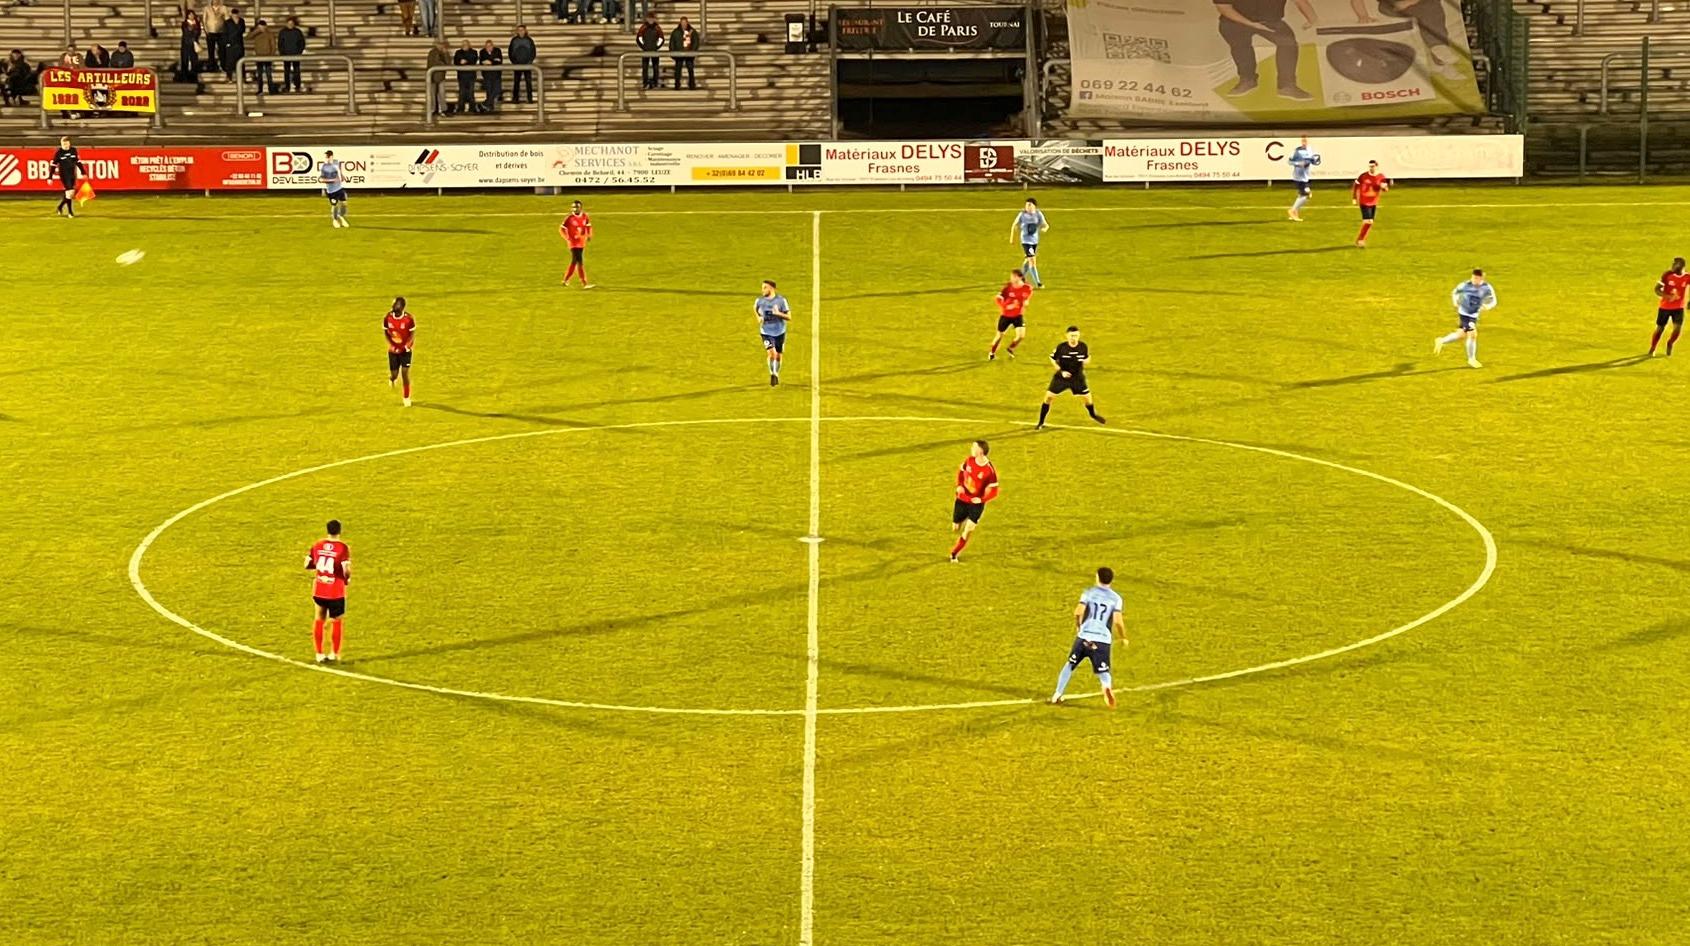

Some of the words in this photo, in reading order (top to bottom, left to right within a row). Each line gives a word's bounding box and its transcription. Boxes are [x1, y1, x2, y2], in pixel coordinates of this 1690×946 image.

[50, 70, 72, 82] LES
[78, 72, 150, 84] ARTILLEURS
[1080, 80, 1114, 90] 069
[1118, 80, 1138, 91] 22
[1144, 82, 1166, 94] 44
[1172, 87, 1192, 98] 62
[1361, 88, 1420, 100] BOSCH
[826, 147, 897, 160] Matériaux
[902, 144, 962, 159] DELYS
[1105, 144, 1175, 157] Matériaux
[1180, 141, 1240, 156] DELYS
[575, 158, 625, 167] SERVICES
[868, 163, 920, 173] Frasnes
[1147, 160, 1199, 170] Frasnes
[316, 556, 334, 574] 44
[1093, 602, 1108, 621] 17
